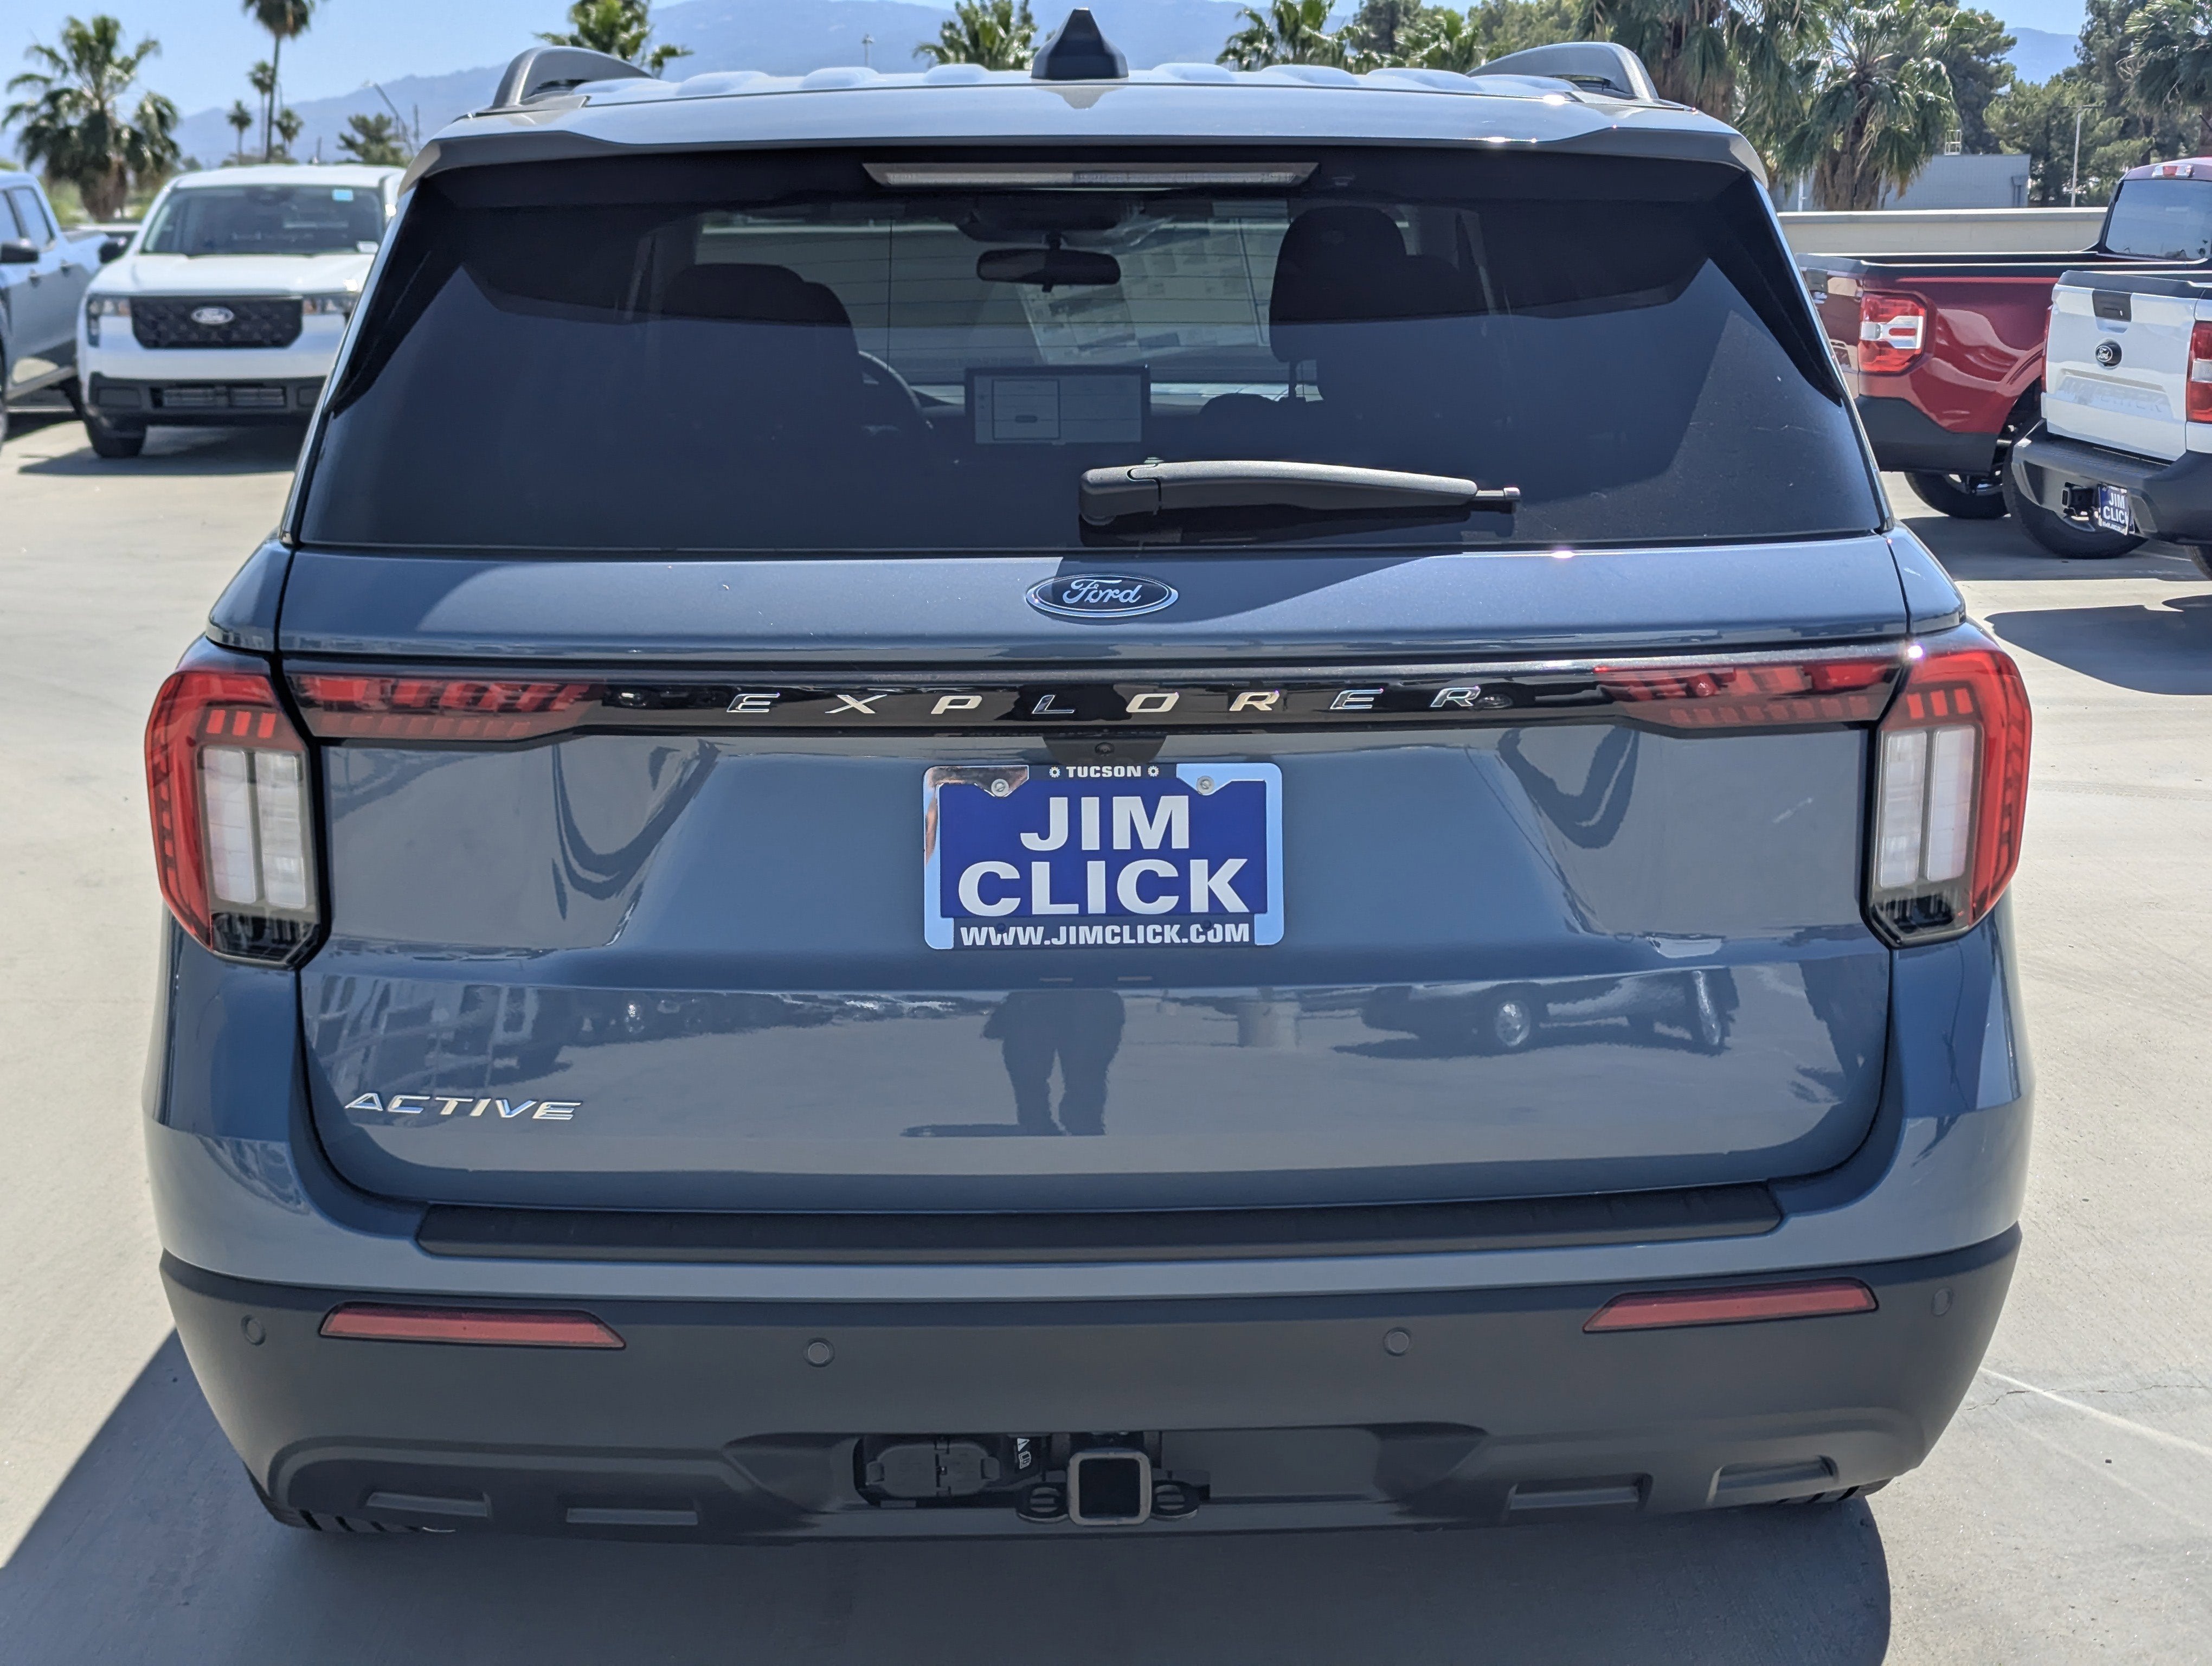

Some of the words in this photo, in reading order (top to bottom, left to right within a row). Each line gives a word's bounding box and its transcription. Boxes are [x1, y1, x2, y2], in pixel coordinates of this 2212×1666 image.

[2109, 492, 2125, 509] JIM
[1063, 579, 1143, 603] Ford
[726, 685, 1480, 714] EXPLORER
[1066, 765, 1142, 778] TUCSON
[1020, 795, 1189, 851] JIM
[958, 858, 1250, 917] CLICK
[960, 924, 1250, 946] WWW.JIMCLICK.COM
[344, 1092, 583, 1120] ACTIVE
